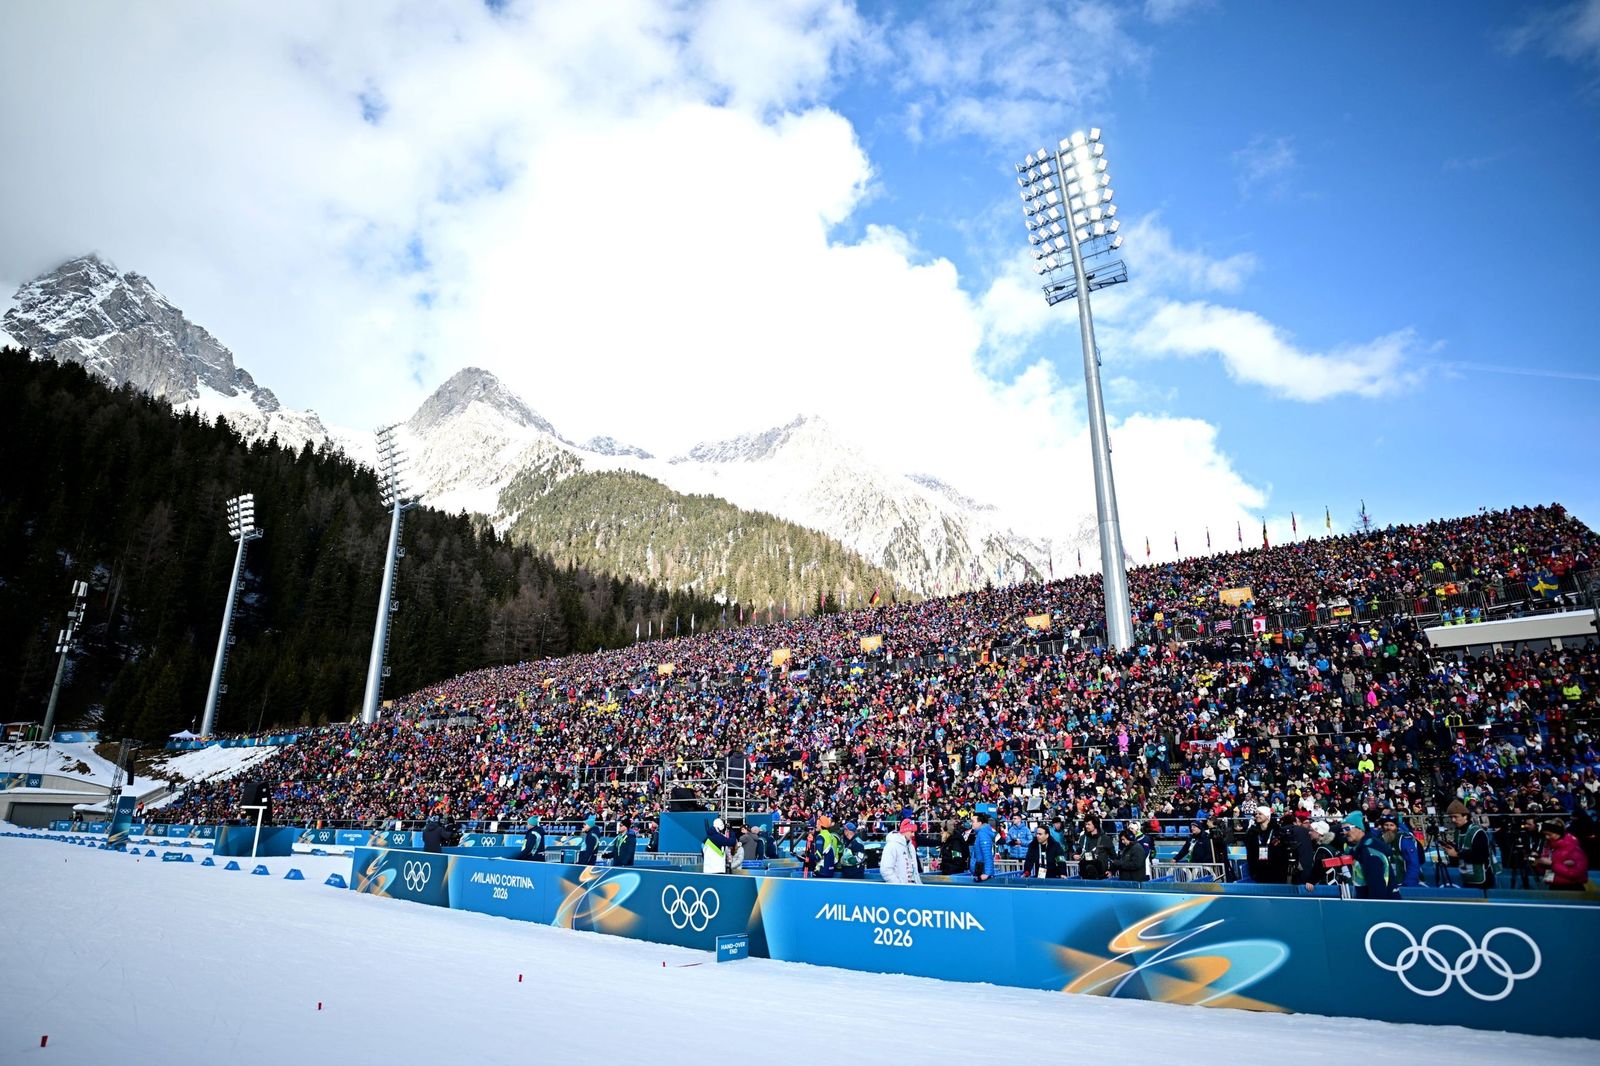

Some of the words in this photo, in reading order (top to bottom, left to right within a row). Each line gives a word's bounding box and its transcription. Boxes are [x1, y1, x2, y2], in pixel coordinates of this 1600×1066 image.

[470, 871, 501, 886] MILANO
[501, 874, 535, 890] CORTINA
[493, 886, 509, 900] 2026
[815, 903, 889, 924] MILANO
[893, 908, 985, 931] CORTINA
[873, 927, 913, 947] 2026
